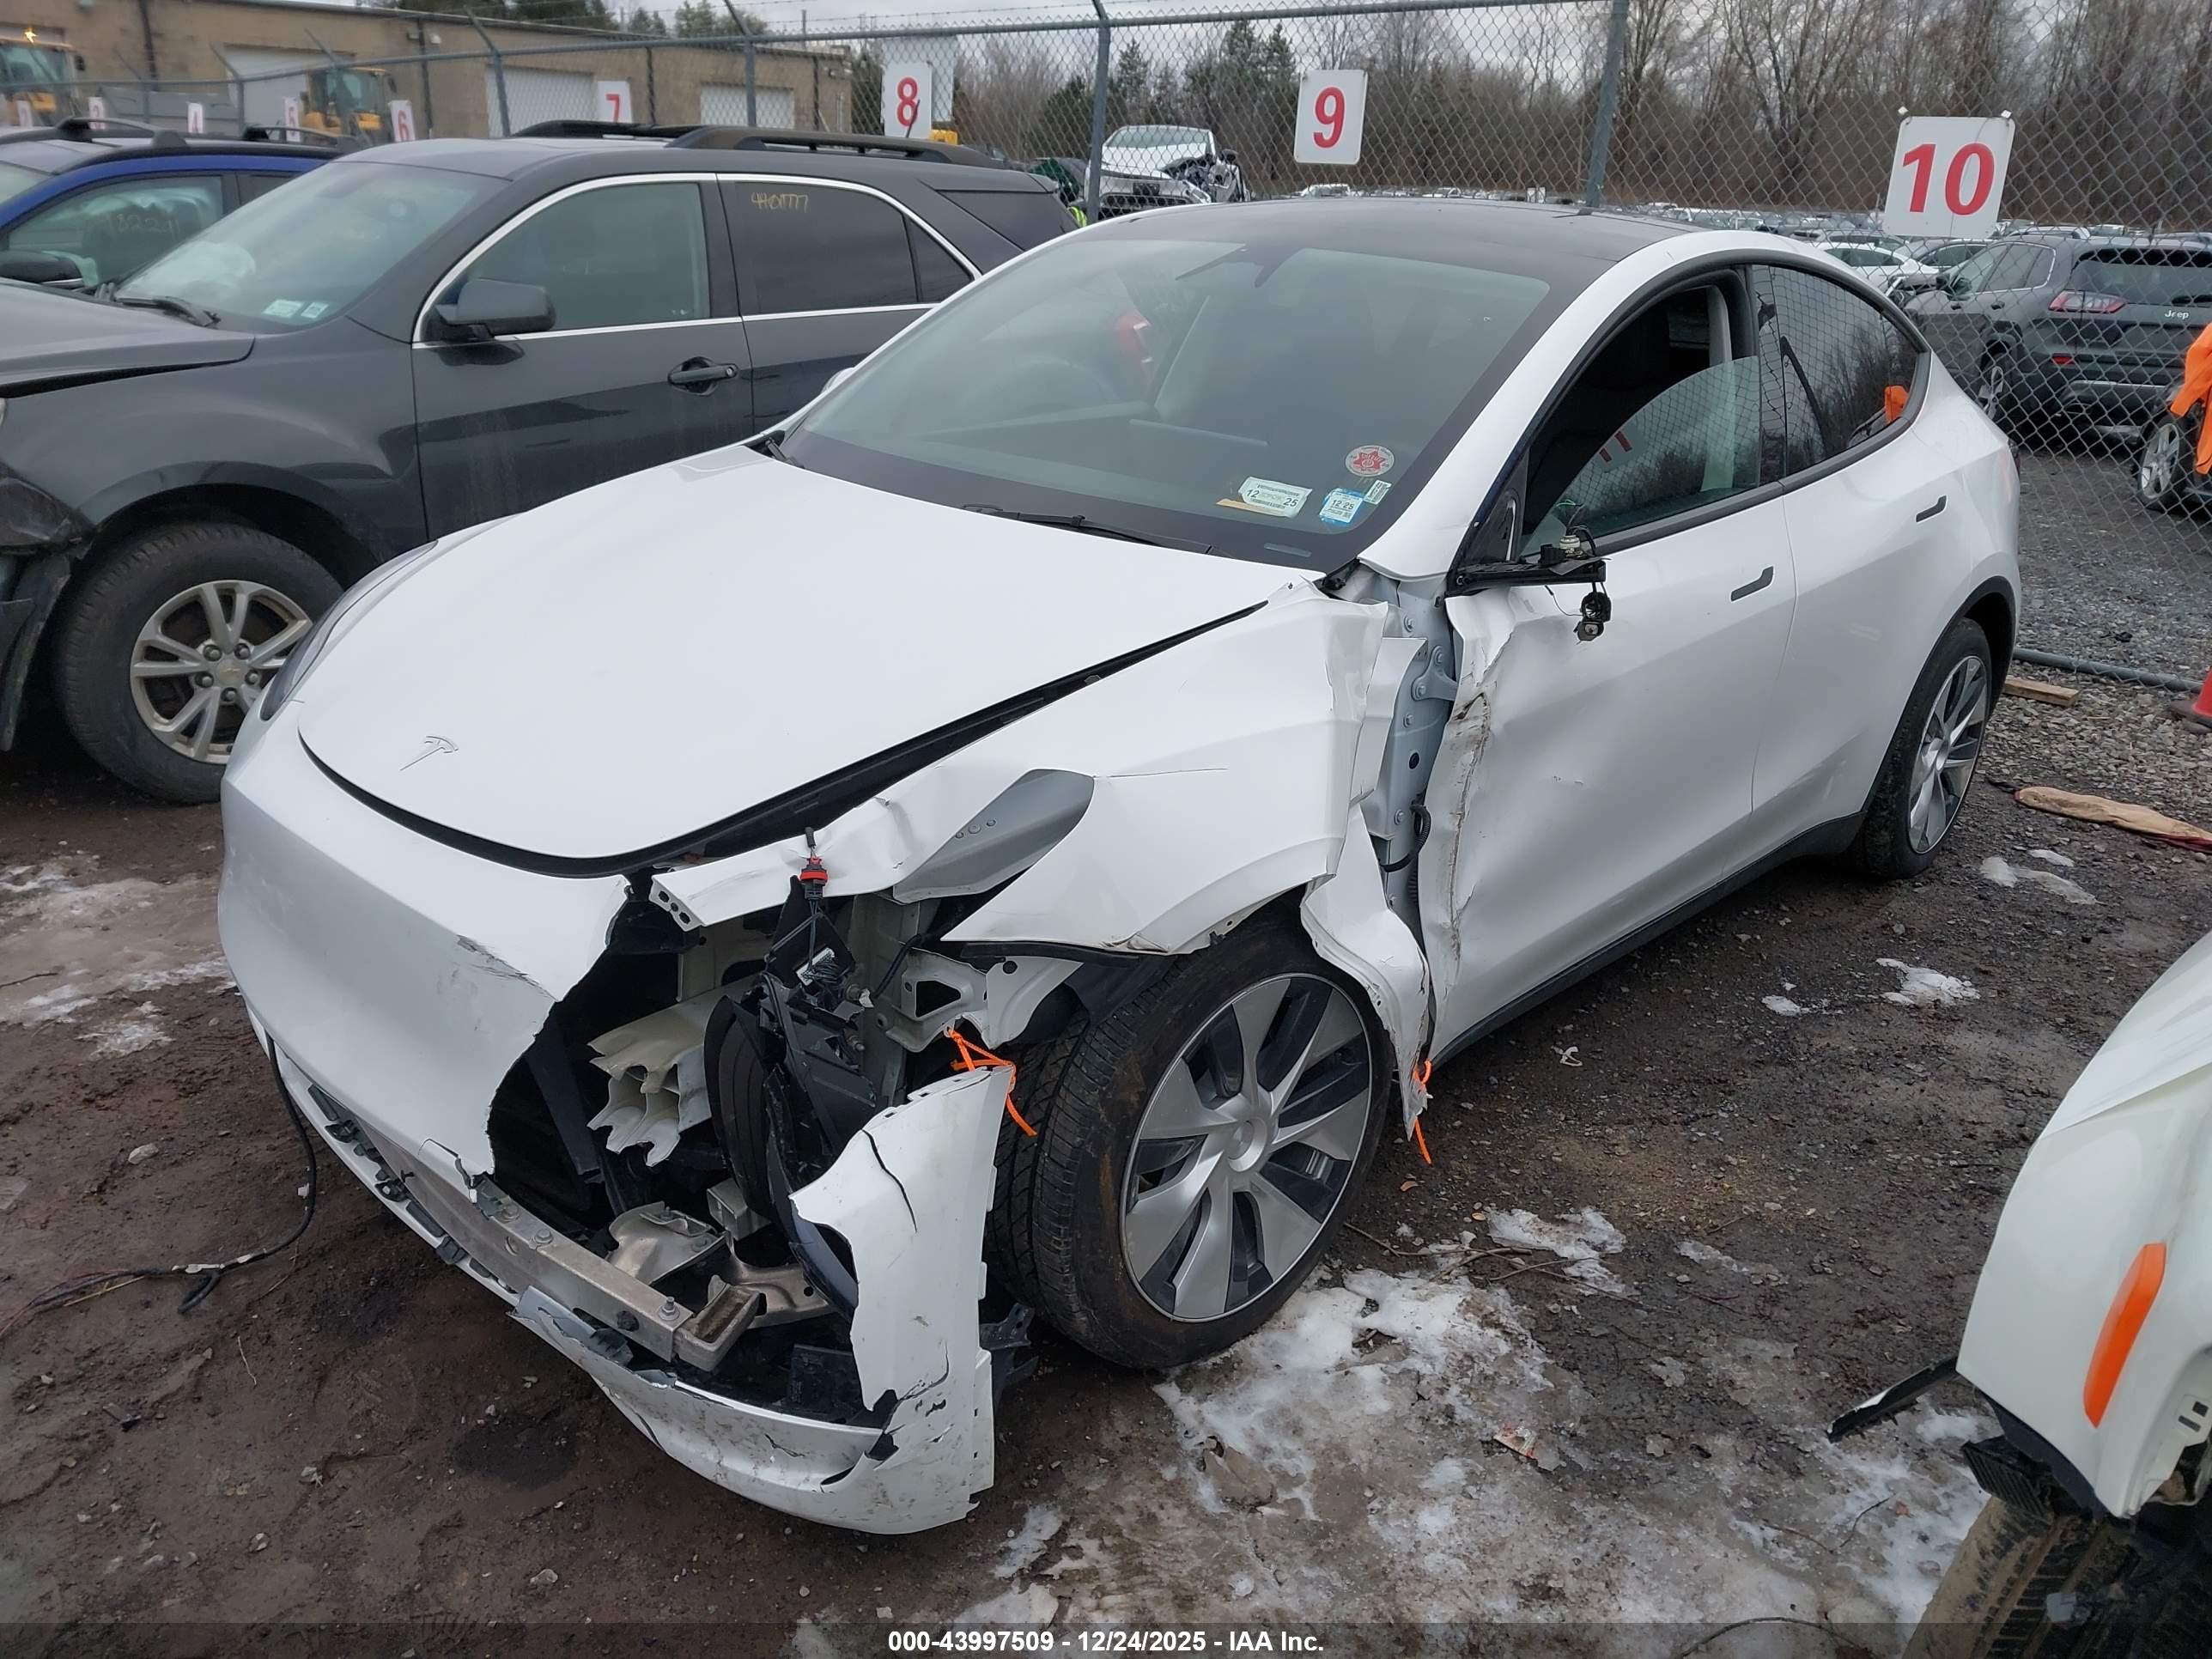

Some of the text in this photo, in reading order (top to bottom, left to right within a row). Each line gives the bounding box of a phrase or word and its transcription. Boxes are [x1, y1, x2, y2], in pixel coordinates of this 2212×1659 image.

[605, 94, 620, 123] 7
[896, 76, 918, 127] 8
[1313, 86, 1345, 149] 9
[398, 109, 410, 142] 6
[1903, 143, 1995, 216] 10
[1246, 489, 1261, 499] 12
[1283, 497, 1299, 507] 25
[1331, 499, 1355, 511] 12 25
